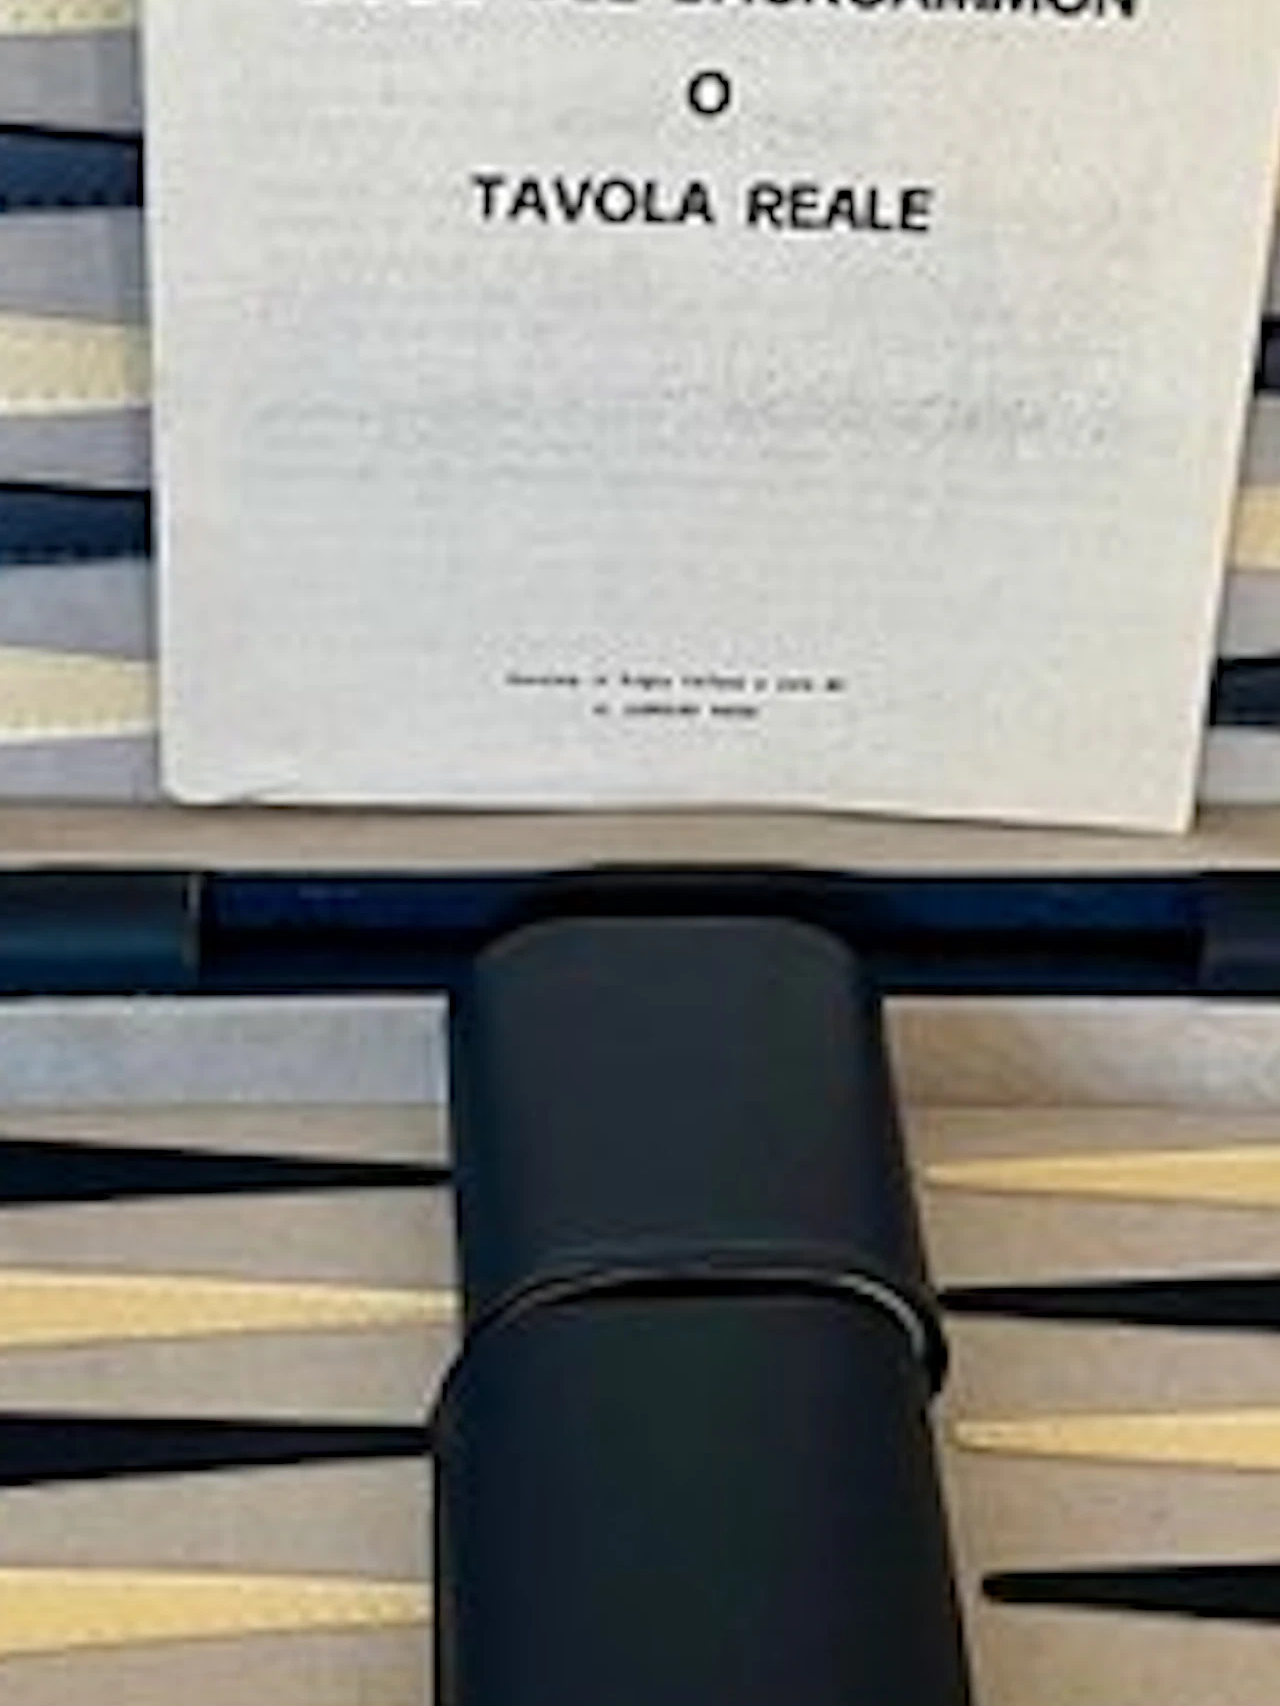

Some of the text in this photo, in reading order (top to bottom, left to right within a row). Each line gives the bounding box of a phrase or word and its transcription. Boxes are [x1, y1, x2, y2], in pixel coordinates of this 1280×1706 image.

[686, 70, 731, 116] O
[473, 175, 933, 233] TAVOLA REALE
